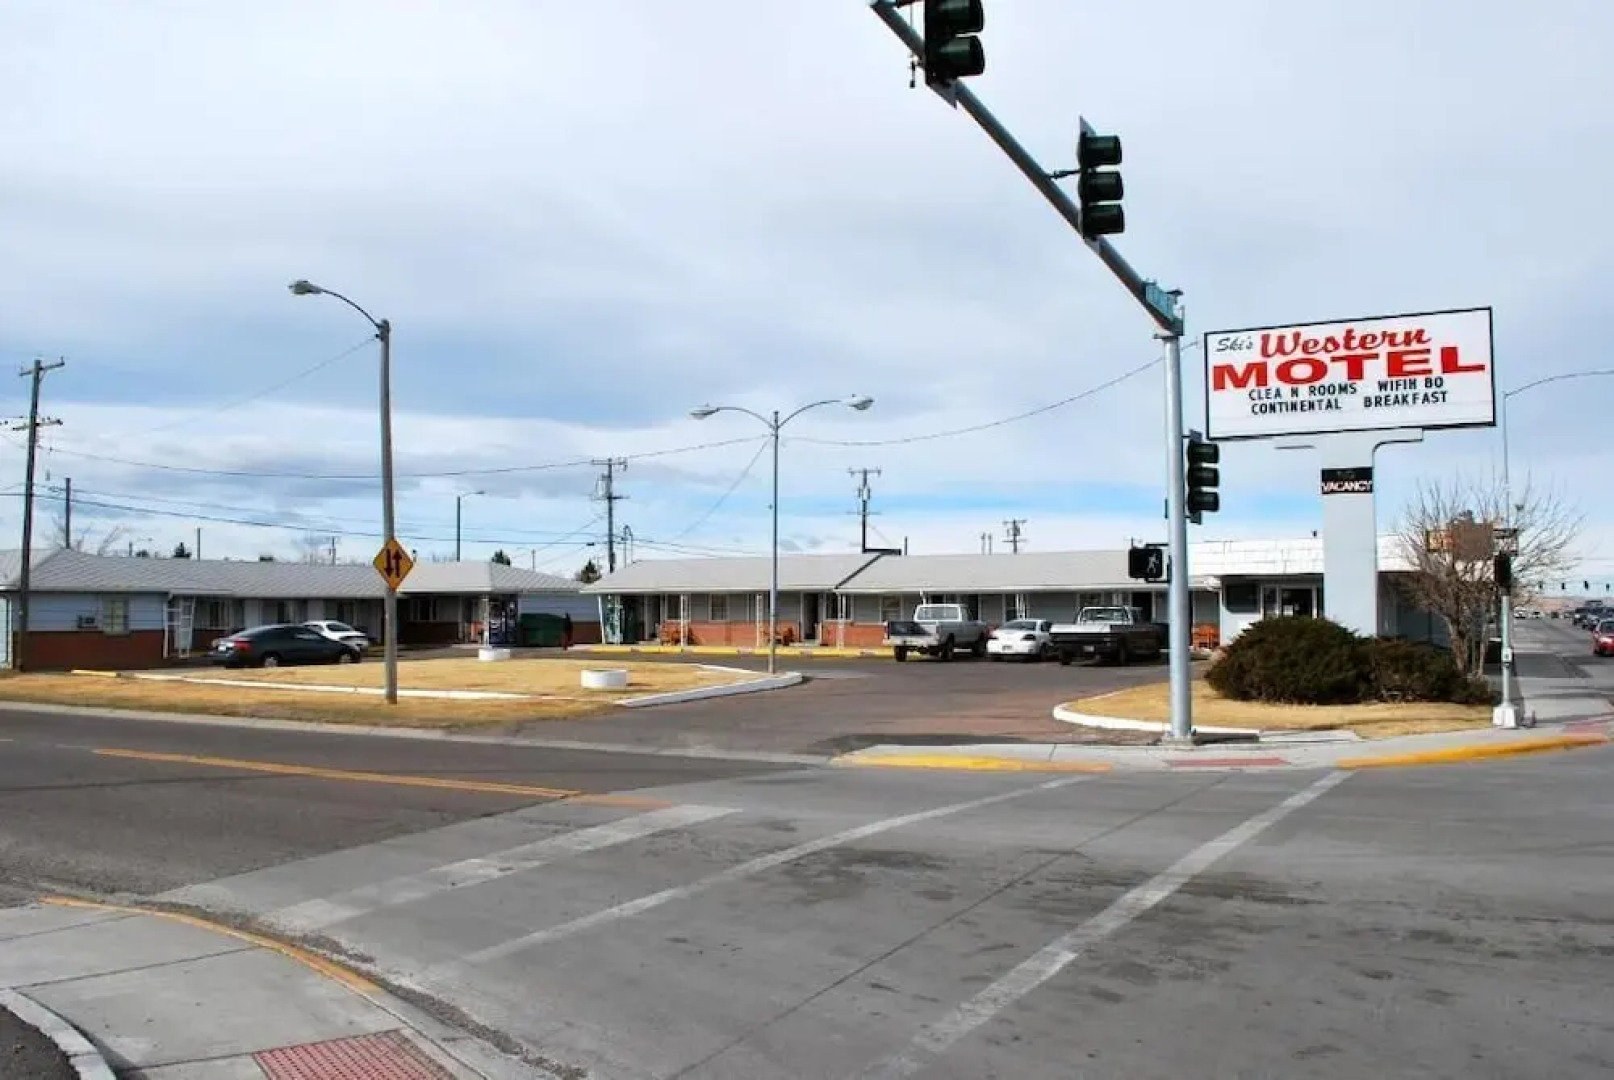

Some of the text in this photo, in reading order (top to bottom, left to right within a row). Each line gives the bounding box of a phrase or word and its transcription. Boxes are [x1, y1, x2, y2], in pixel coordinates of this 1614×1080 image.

[1216, 326, 1432, 357] Ski's Western
[1213, 347, 1486, 391] MOTEL
[1308, 382, 1357, 397] ROOMS
[1251, 391, 1448, 415] CONTINENTAL BREAKFAST
[1321, 480, 1372, 492] VACANCY
